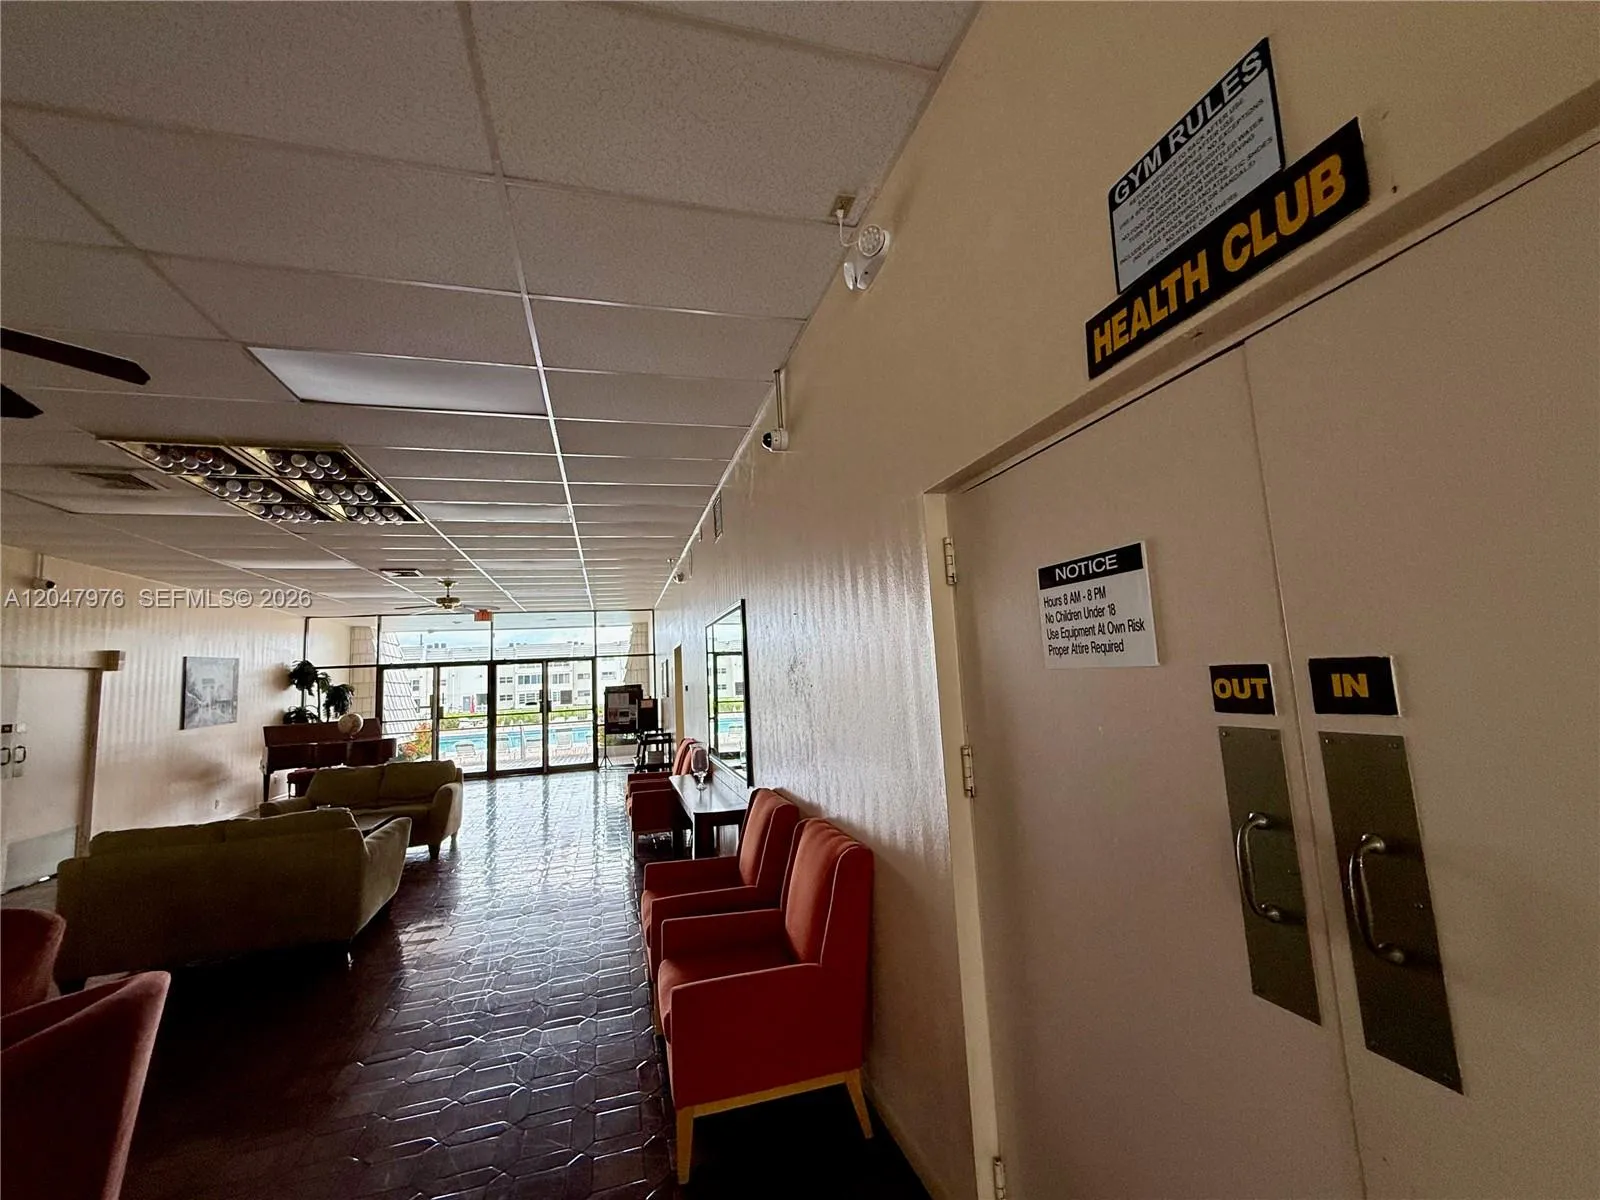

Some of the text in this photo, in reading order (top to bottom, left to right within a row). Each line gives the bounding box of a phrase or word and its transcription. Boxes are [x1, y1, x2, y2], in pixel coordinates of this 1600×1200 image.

[1115, 50, 1265, 204] GYM RULES
[1159, 173, 1177, 194] WHEN
[1217, 95, 1264, 142] EXCEPTIONS
[1150, 158, 1177, 187] WEIGHTS
[1186, 131, 1205, 154] RACK
[1205, 110, 1228, 136] AFTER
[1161, 148, 1196, 185] EQUIPMENT
[1197, 127, 1219, 152] AFTER
[1219, 113, 1235, 133] USE
[1129, 217, 1145, 236] FOOD
[1204, 137, 1237, 171] BOTTLED
[1237, 114, 1264, 143] WATER
[1164, 178, 1182, 198] DROP
[1181, 166, 1195, 183] THE
[1176, 186, 1190, 203] AND
[1202, 158, 1223, 181] WHEN
[1196, 185, 1211, 203] AND
[1212, 156, 1246, 190] ATHLETIC
[1094, 153, 1346, 364] HEALTH CLUB
[1055, 554, 1118, 581] NOTICE
[1043, 597, 1062, 608] Hours
[1063, 593, 1069, 605] 8
[1070, 590, 1081, 604] AM
[1087, 589, 1093, 601] 8
[1094, 586, 1106, 600] PM
[1045, 603, 1116, 624] No Children Under 18
[1047, 618, 1146, 641] Use Equipment At Own Risk
[1048, 639, 1124, 658] Proper Attire Required
[1214, 677, 1268, 699] OUT
[1331, 673, 1369, 698] IN
